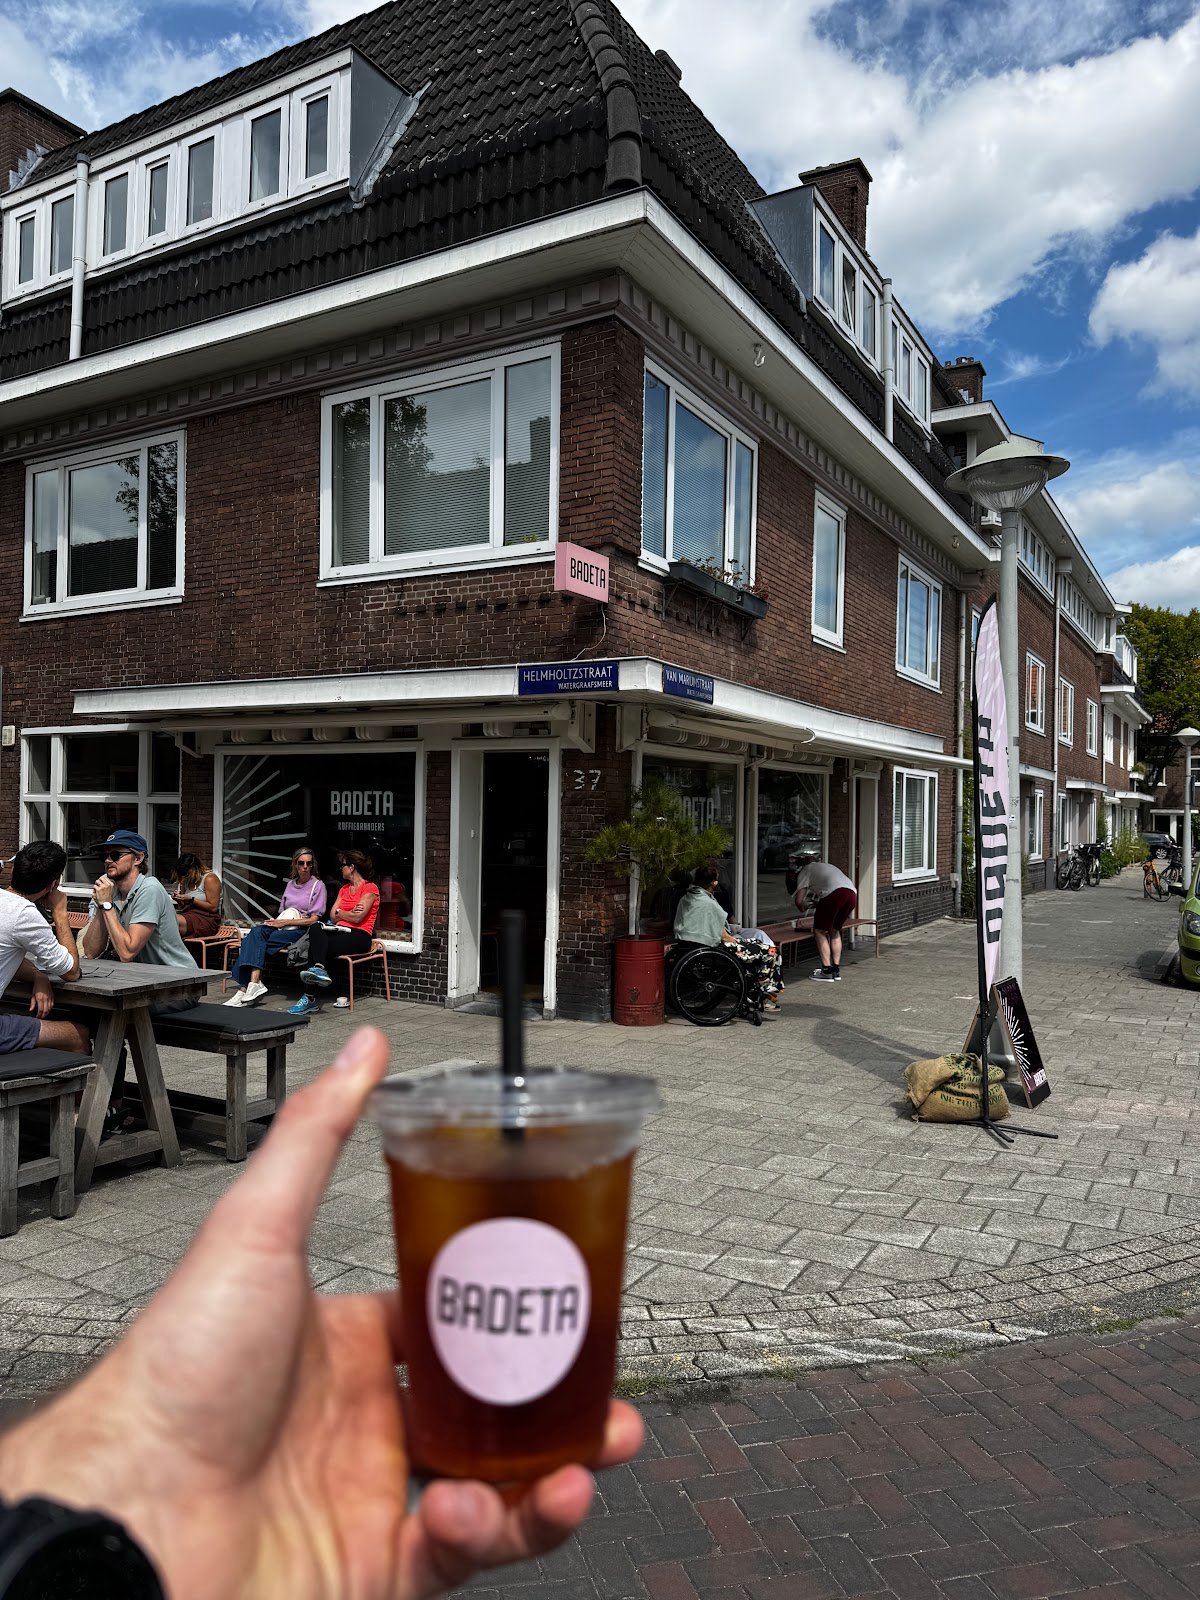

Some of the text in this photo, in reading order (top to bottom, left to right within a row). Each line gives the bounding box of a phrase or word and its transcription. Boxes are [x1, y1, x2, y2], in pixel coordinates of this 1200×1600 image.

[570, 557, 606, 589] BADETA
[523, 665, 613, 682] HELMHOLTZSTRAAT
[665, 669, 677, 683] VAN
[557, 680, 613, 690] WATERGRAAFSMEER
[573, 769, 602, 791] 37
[330, 790, 394, 816] BADETA
[435, 1275, 580, 1337] BADETA
